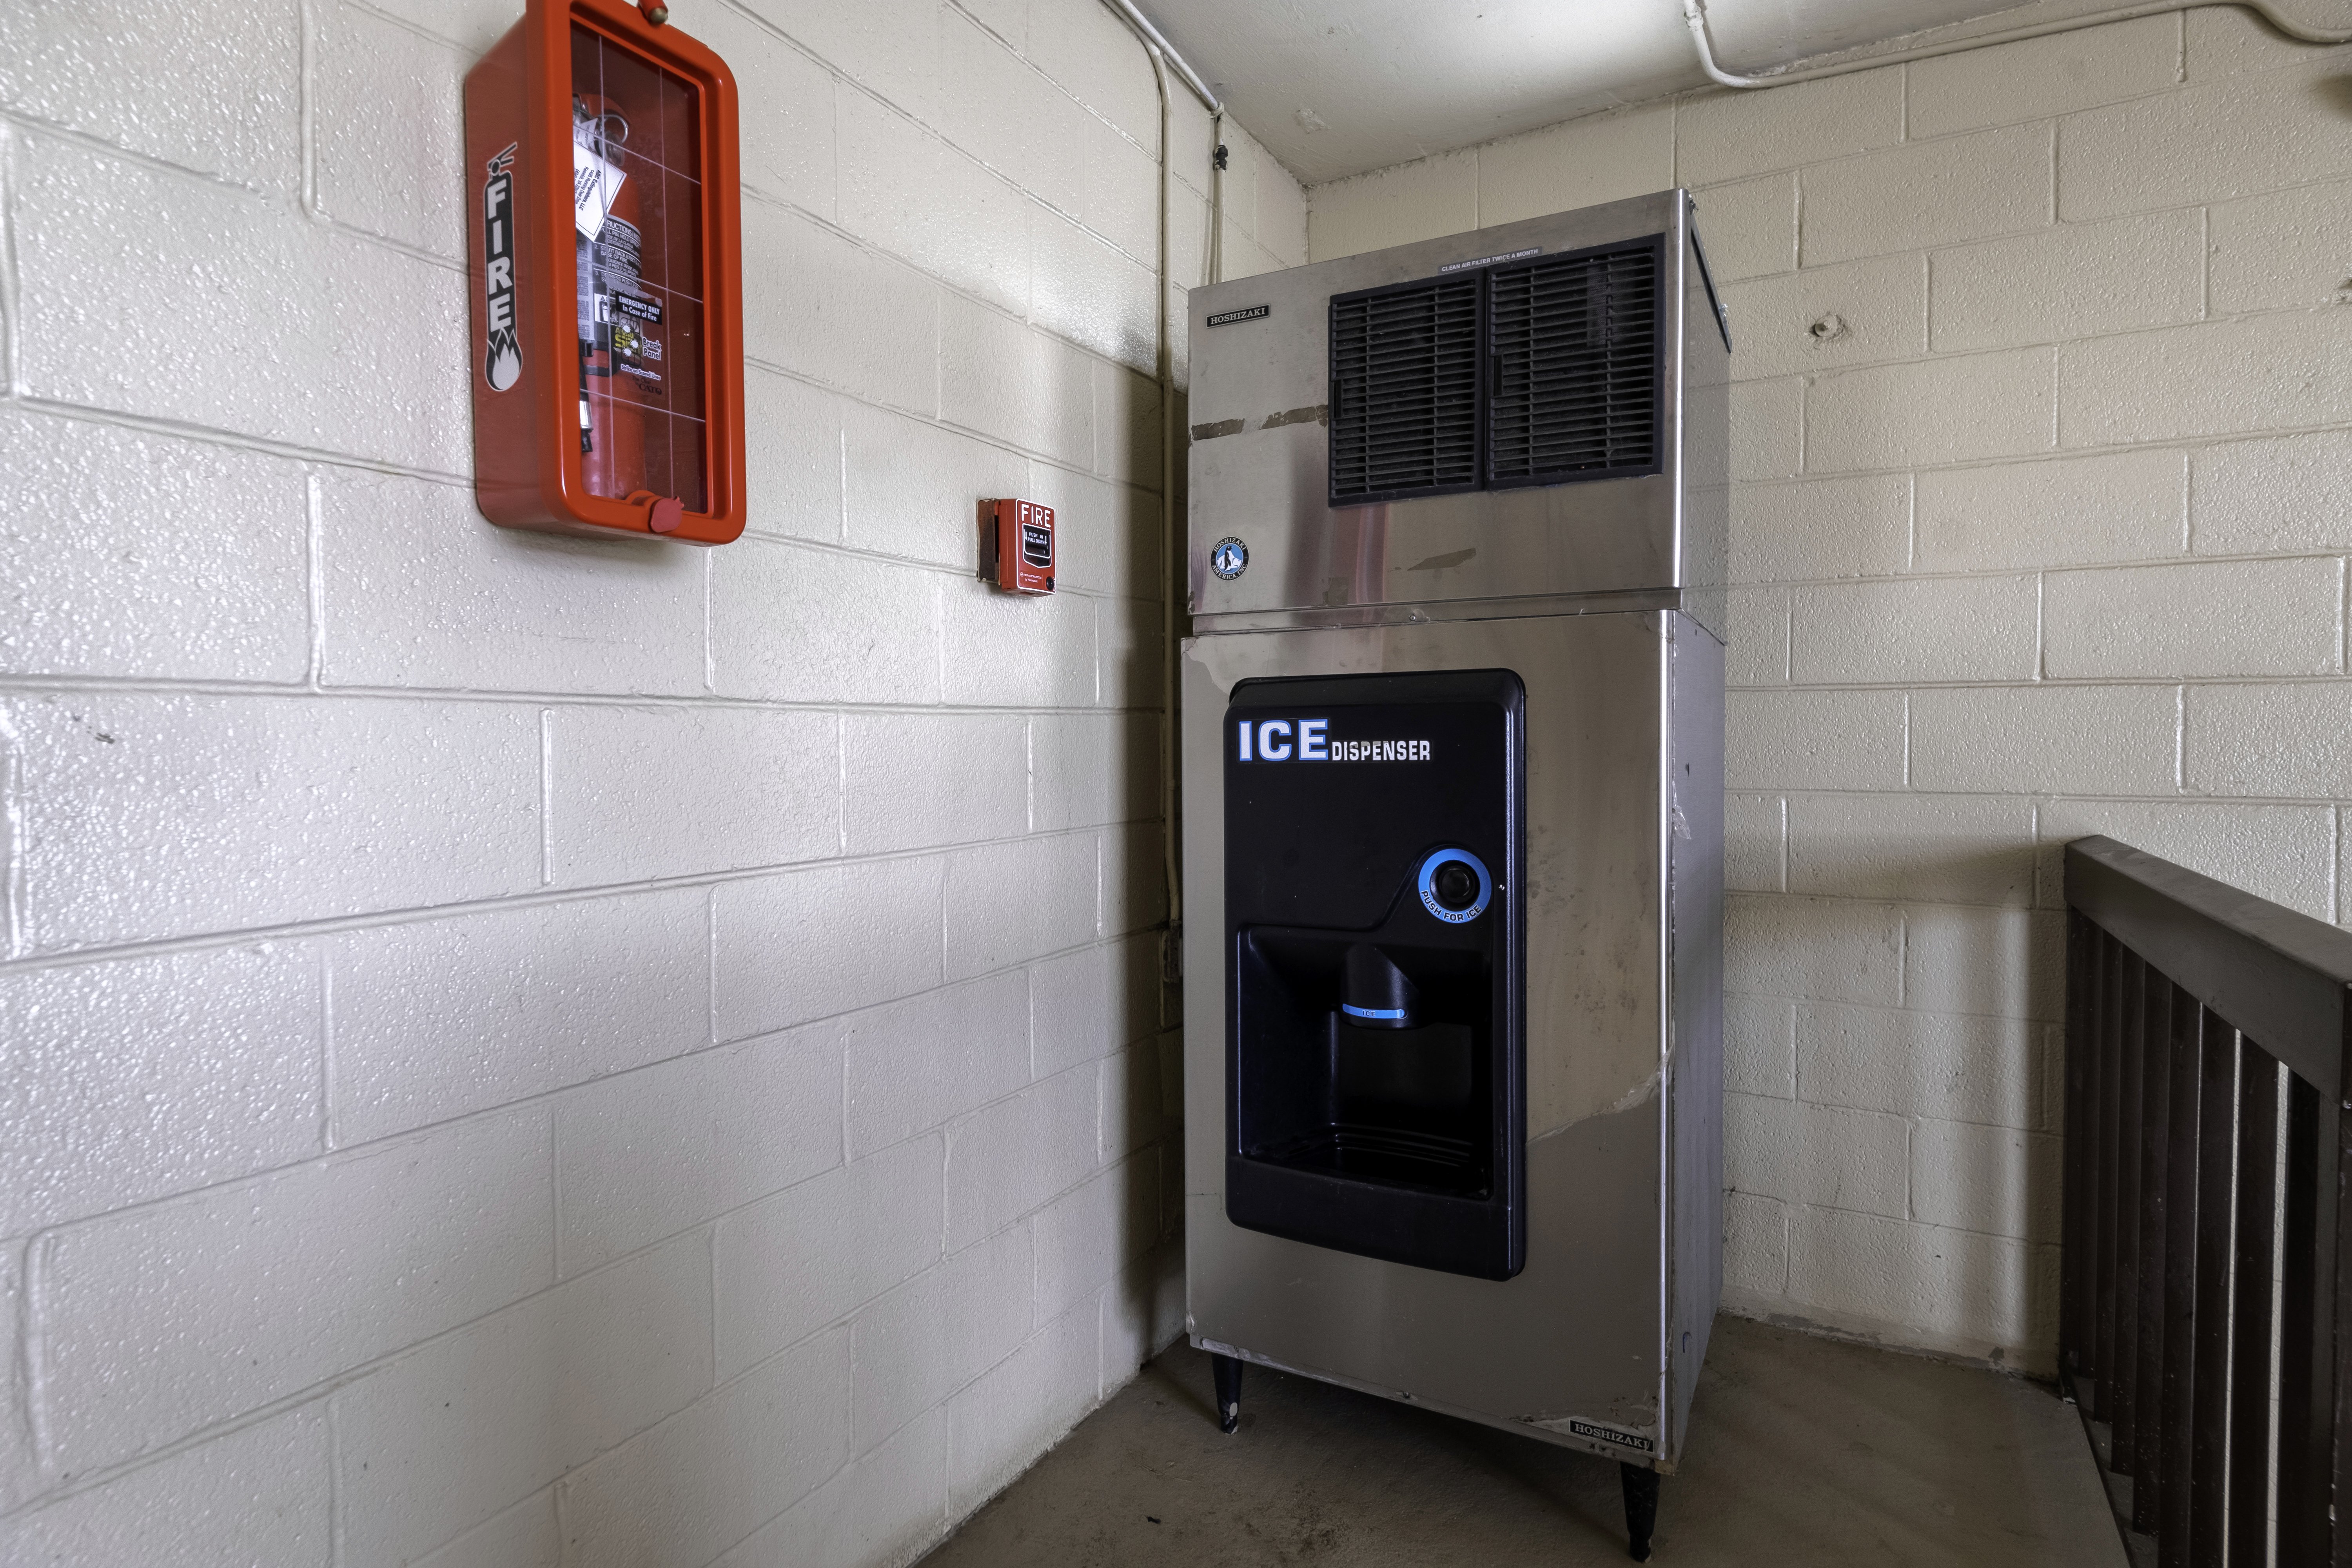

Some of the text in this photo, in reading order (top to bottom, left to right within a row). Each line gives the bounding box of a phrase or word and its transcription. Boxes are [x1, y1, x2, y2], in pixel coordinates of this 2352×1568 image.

[608, 240, 623, 248] OSTENGA
[488, 179, 513, 332] FIRE
[1442, 263, 1460, 272] CLEAN
[1516, 249, 1538, 258] MONTH
[619, 296, 647, 310] EMERGENCY
[648, 306, 660, 315] ONLY
[629, 307, 641, 316] Case
[648, 313, 657, 321] Fire
[1210, 308, 1265, 325] HOSHIZAKI
[643, 337, 661, 350] Break
[644, 347, 661, 360] Panel
[1022, 504, 1051, 528] FIRE
[1214, 538, 1247, 552] HOSHIZAKI
[1238, 563, 1247, 575] INC.
[1239, 719, 1430, 761] ICE DISPENSER
[1421, 890, 1483, 922] PUSH FOR ICE
[1575, 1423, 1649, 1450] HOSHIZAKI
